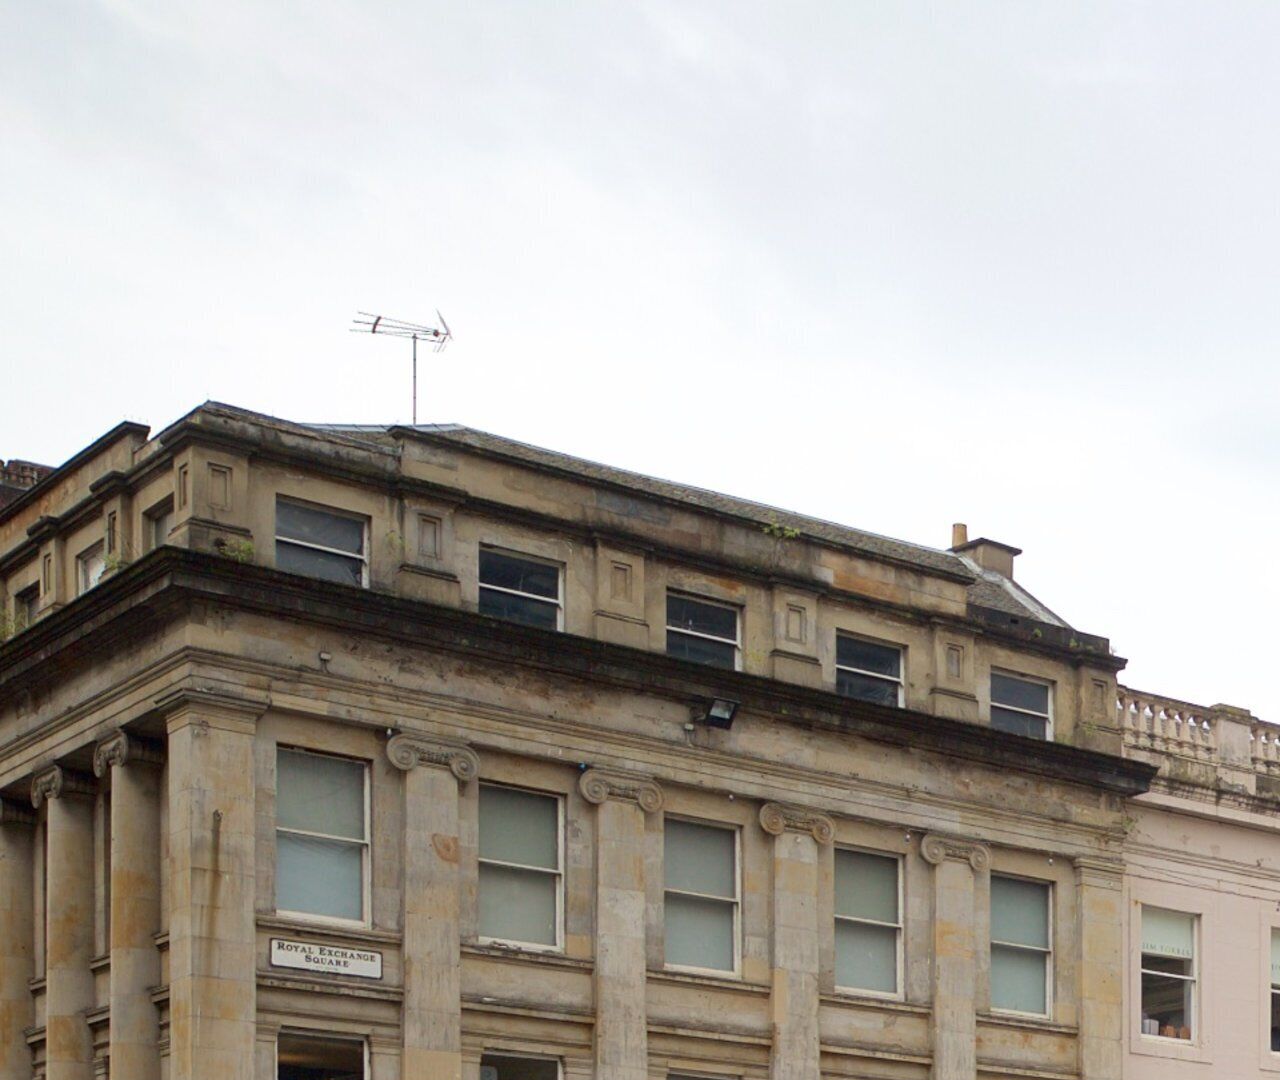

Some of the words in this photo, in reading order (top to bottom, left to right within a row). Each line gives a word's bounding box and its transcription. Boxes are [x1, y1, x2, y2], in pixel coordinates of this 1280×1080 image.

[277, 941, 315, 955] ROYAL
[319, 946, 377, 963] EXCHANGE
[304, 954, 350, 968] SQUARE
